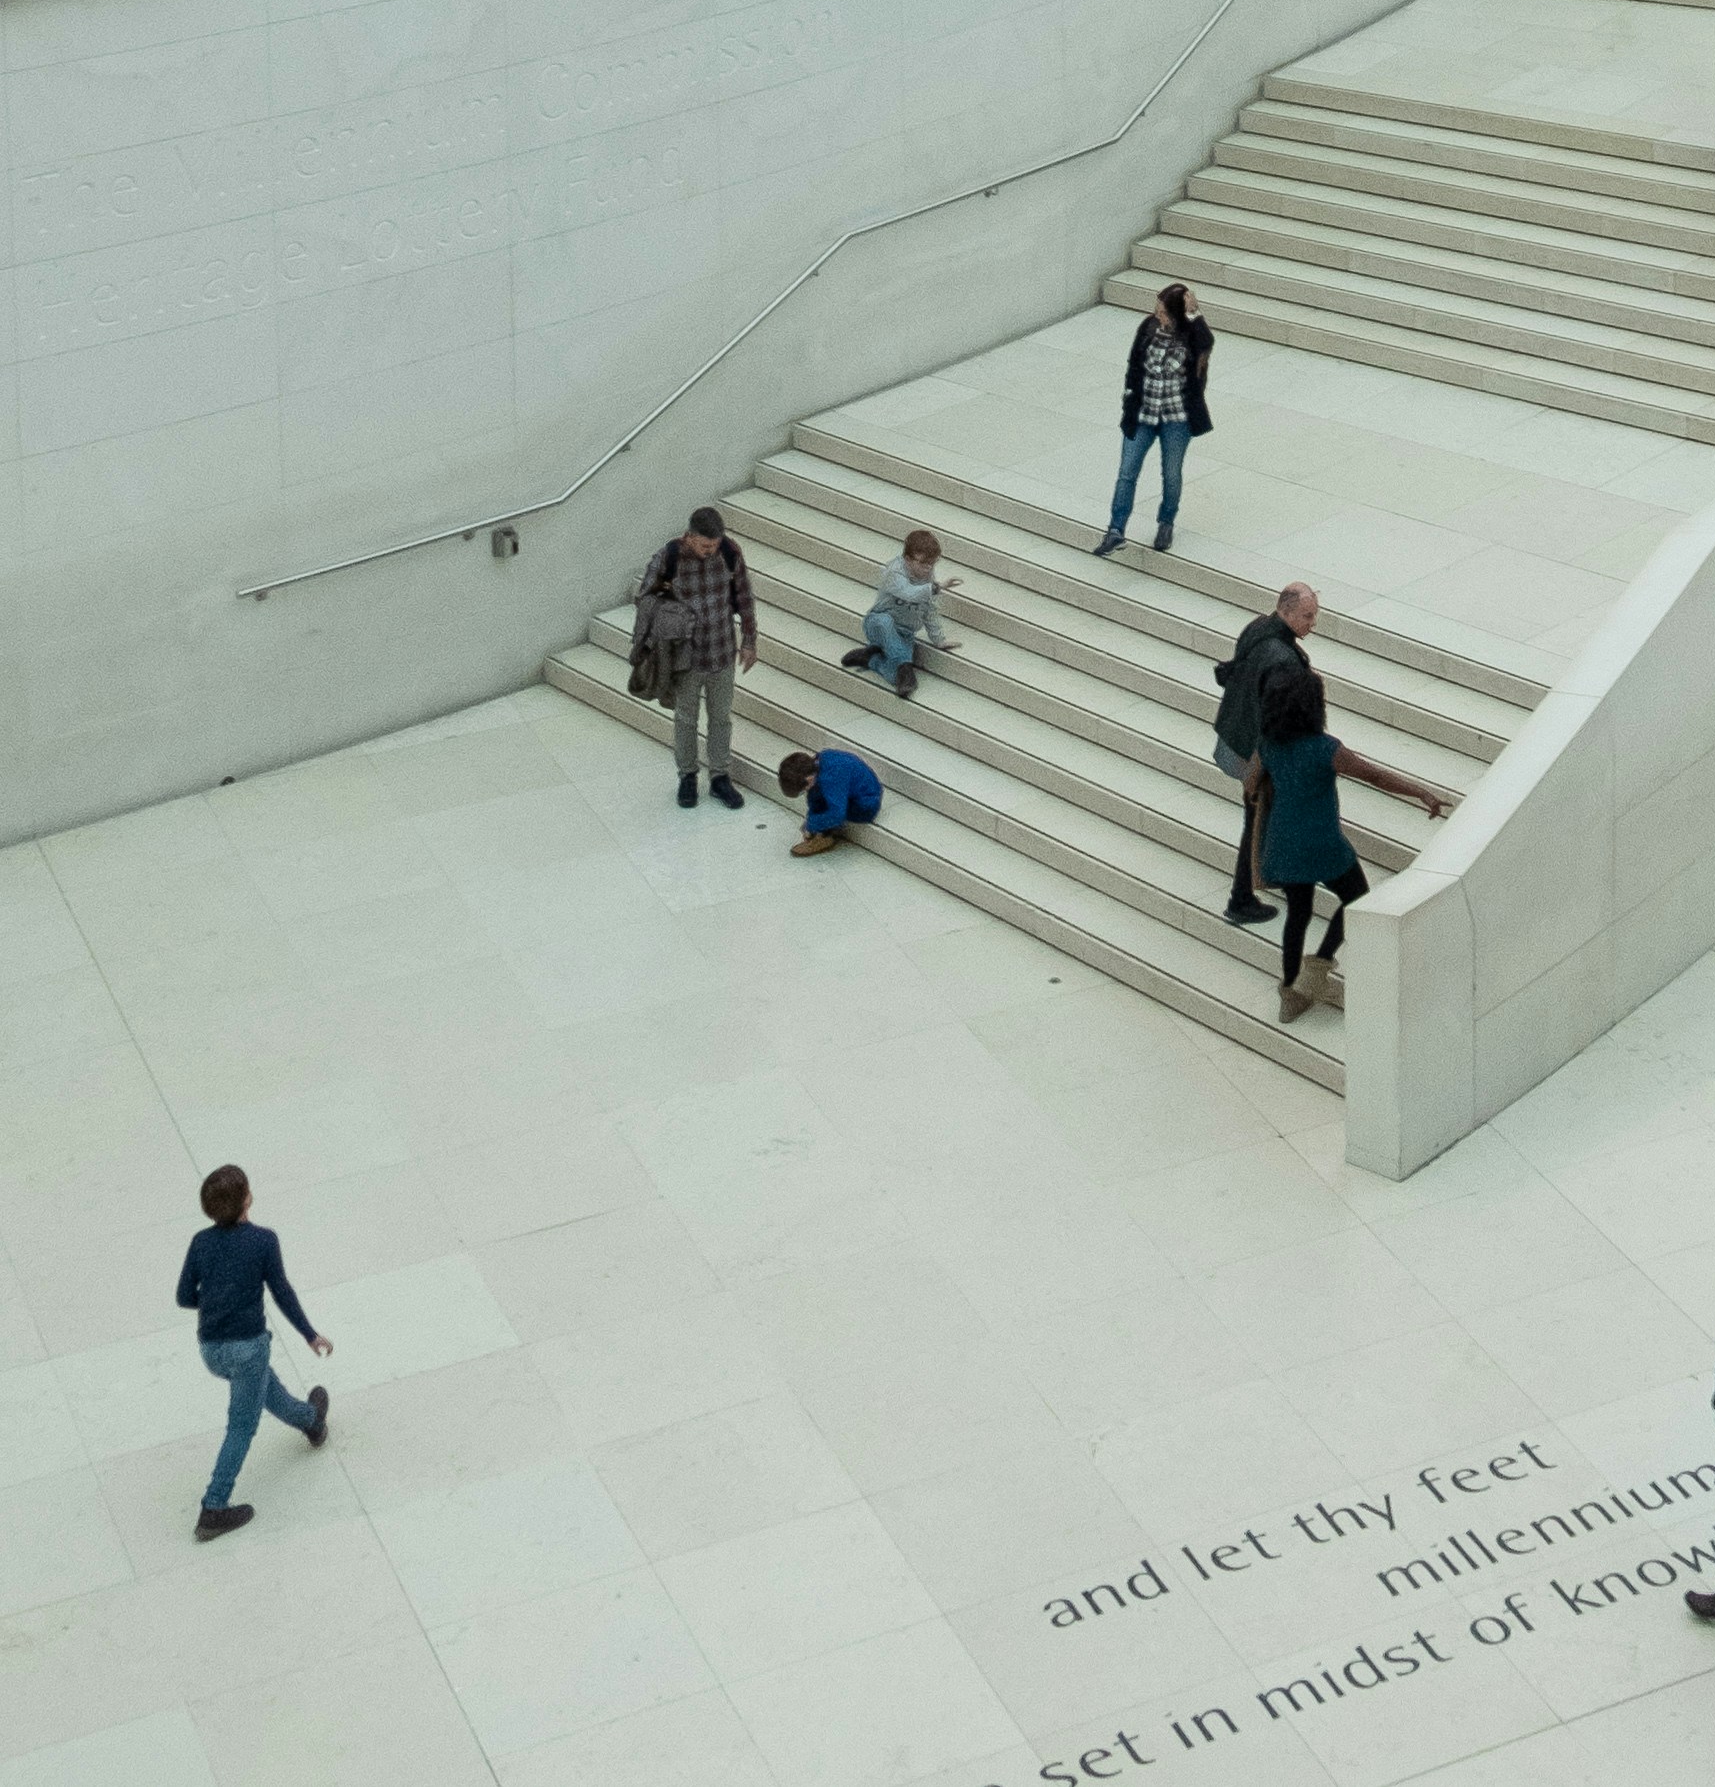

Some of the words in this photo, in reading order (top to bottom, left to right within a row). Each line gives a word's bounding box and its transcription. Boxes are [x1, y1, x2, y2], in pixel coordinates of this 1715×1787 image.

[1043, 1559, 1171, 1629] and
[1181, 1529, 1282, 1581] let
[1293, 1491, 1398, 1534] thy
[1415, 1438, 1557, 1506] feet
[1040, 1729, 1156, 1787] set
[1168, 1705, 1240, 1750] in
[1255, 1630, 1454, 1720] midst
[1468, 1592, 1537, 1650] of
